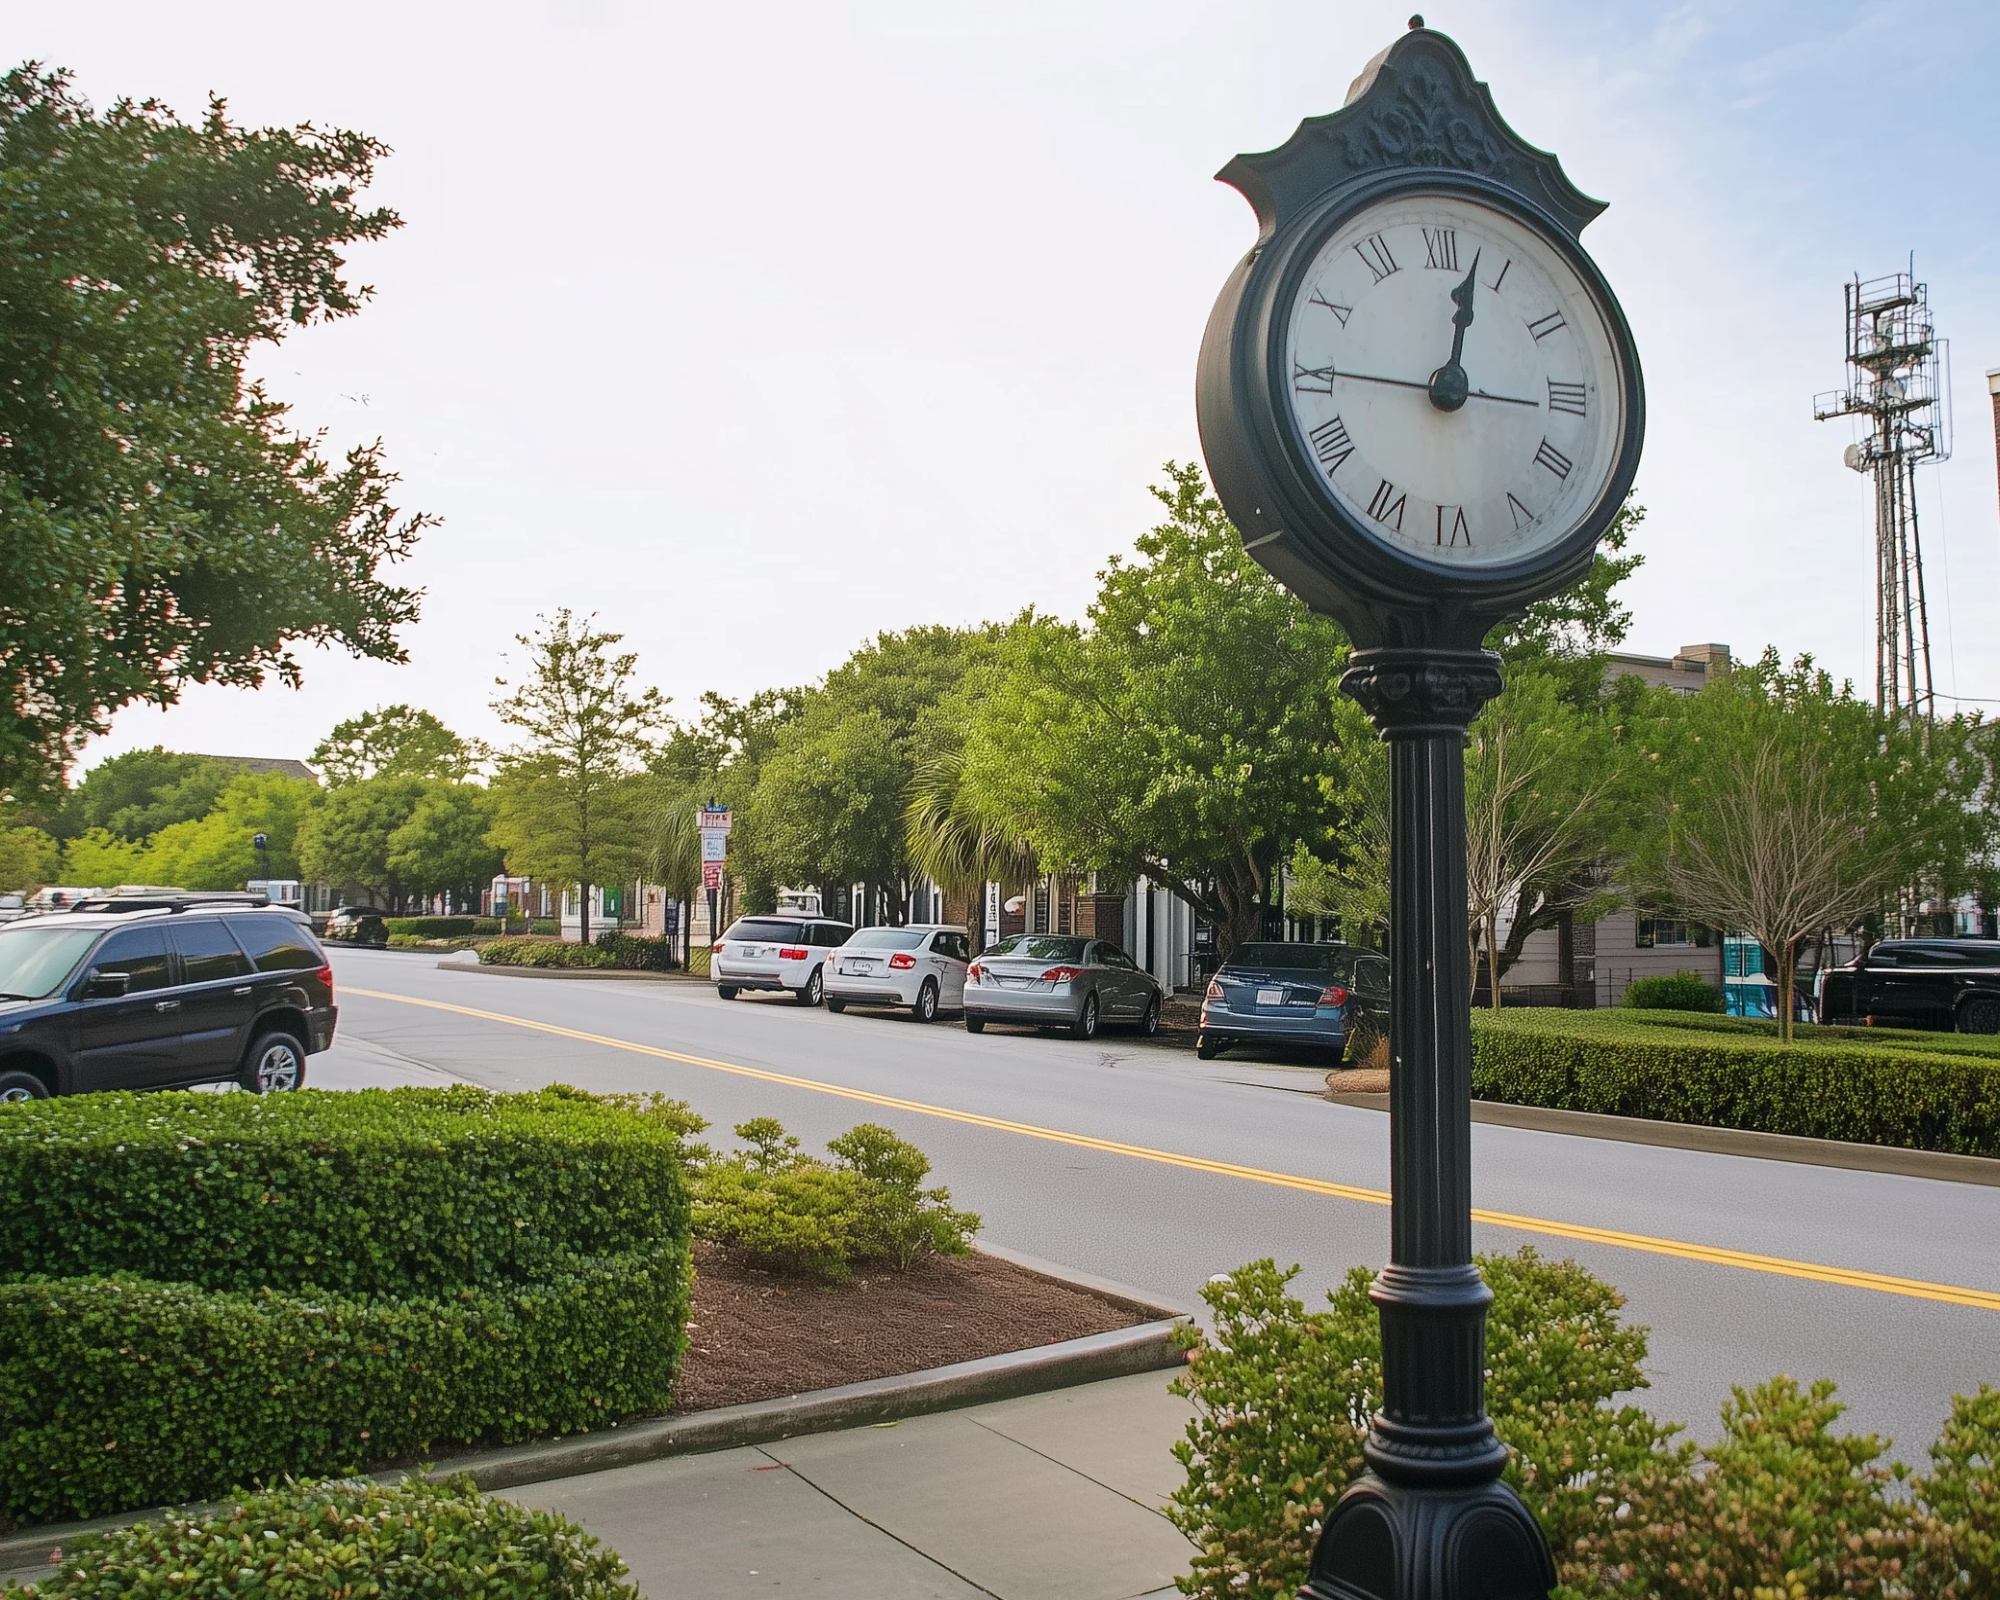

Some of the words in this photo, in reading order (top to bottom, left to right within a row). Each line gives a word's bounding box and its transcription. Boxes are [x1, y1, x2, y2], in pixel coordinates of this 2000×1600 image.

[1485, 259, 1512, 294] I
[1309, 289, 1352, 329] X
[1525, 310, 1567, 345] II
[1547, 375, 1586, 417] IIII
[1507, 491, 1534, 529] V
